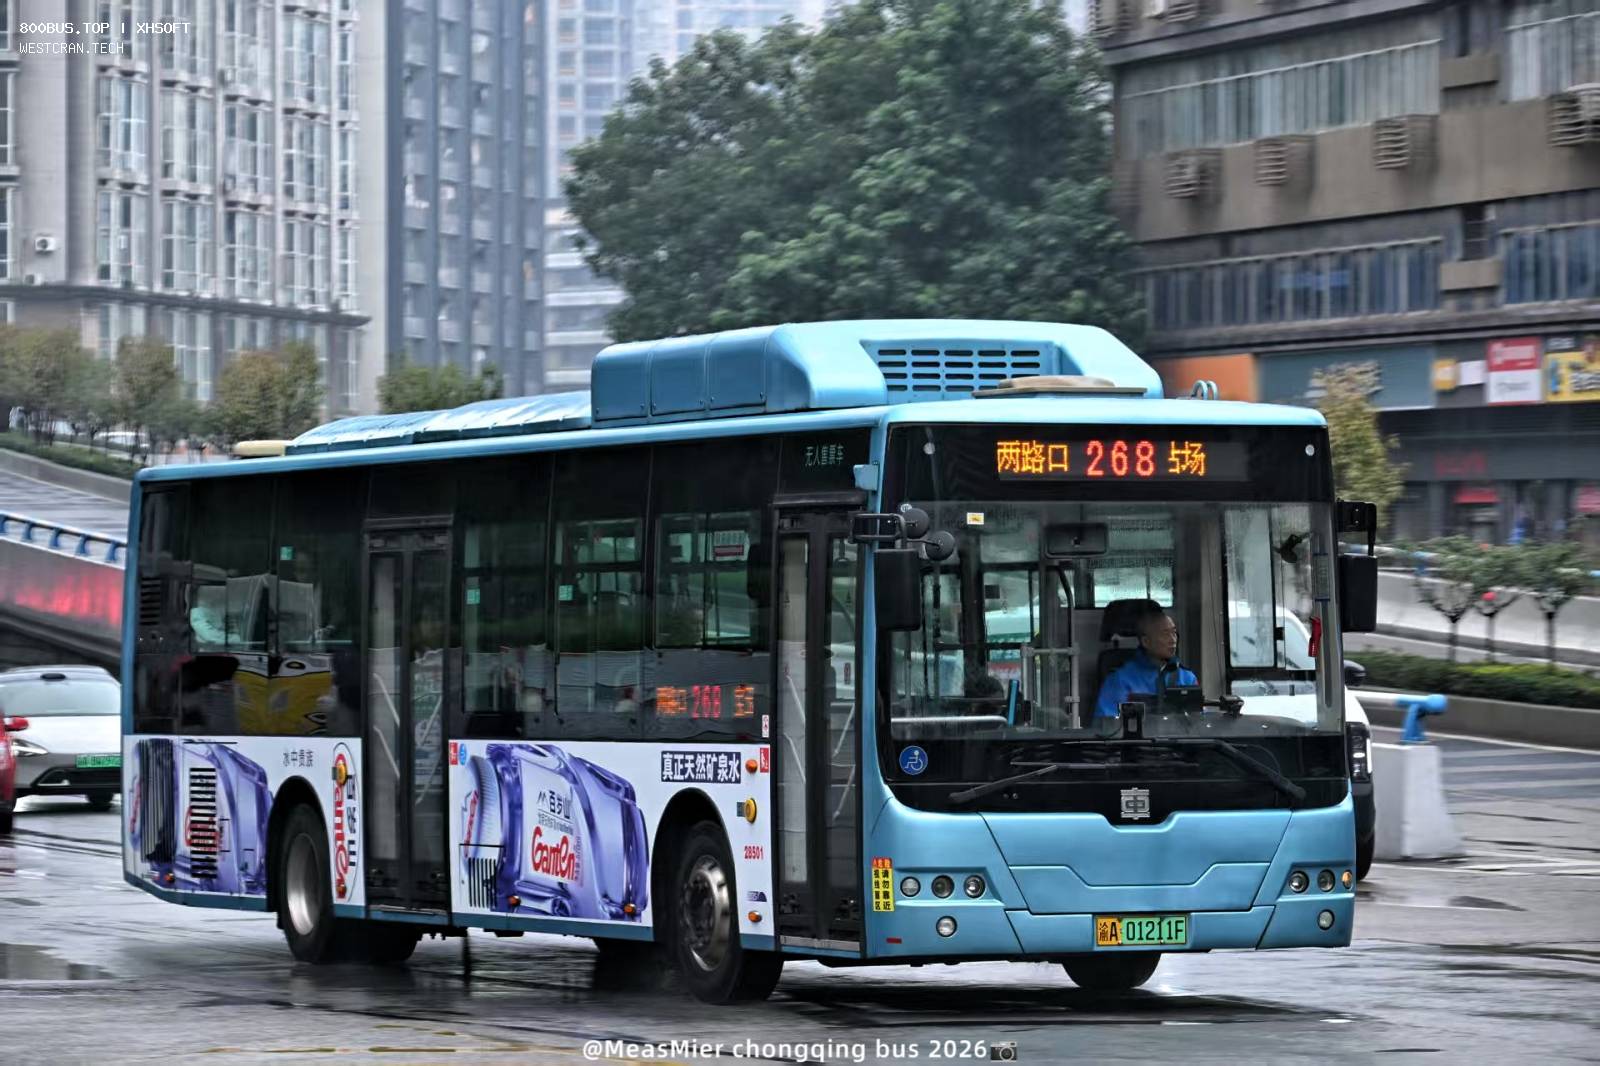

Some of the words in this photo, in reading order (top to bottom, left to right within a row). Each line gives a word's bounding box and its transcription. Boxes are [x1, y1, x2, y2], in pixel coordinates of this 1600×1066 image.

[996, 440, 1068, 474] 两路口
[1085, 440, 1155, 476] 268
[662, 753, 740, 782] 真正天然矿泉水
[743, 845, 764, 860] 28501
[1100, 921, 1118, 942] 渝A
[1126, 920, 1184, 941] 01211F
